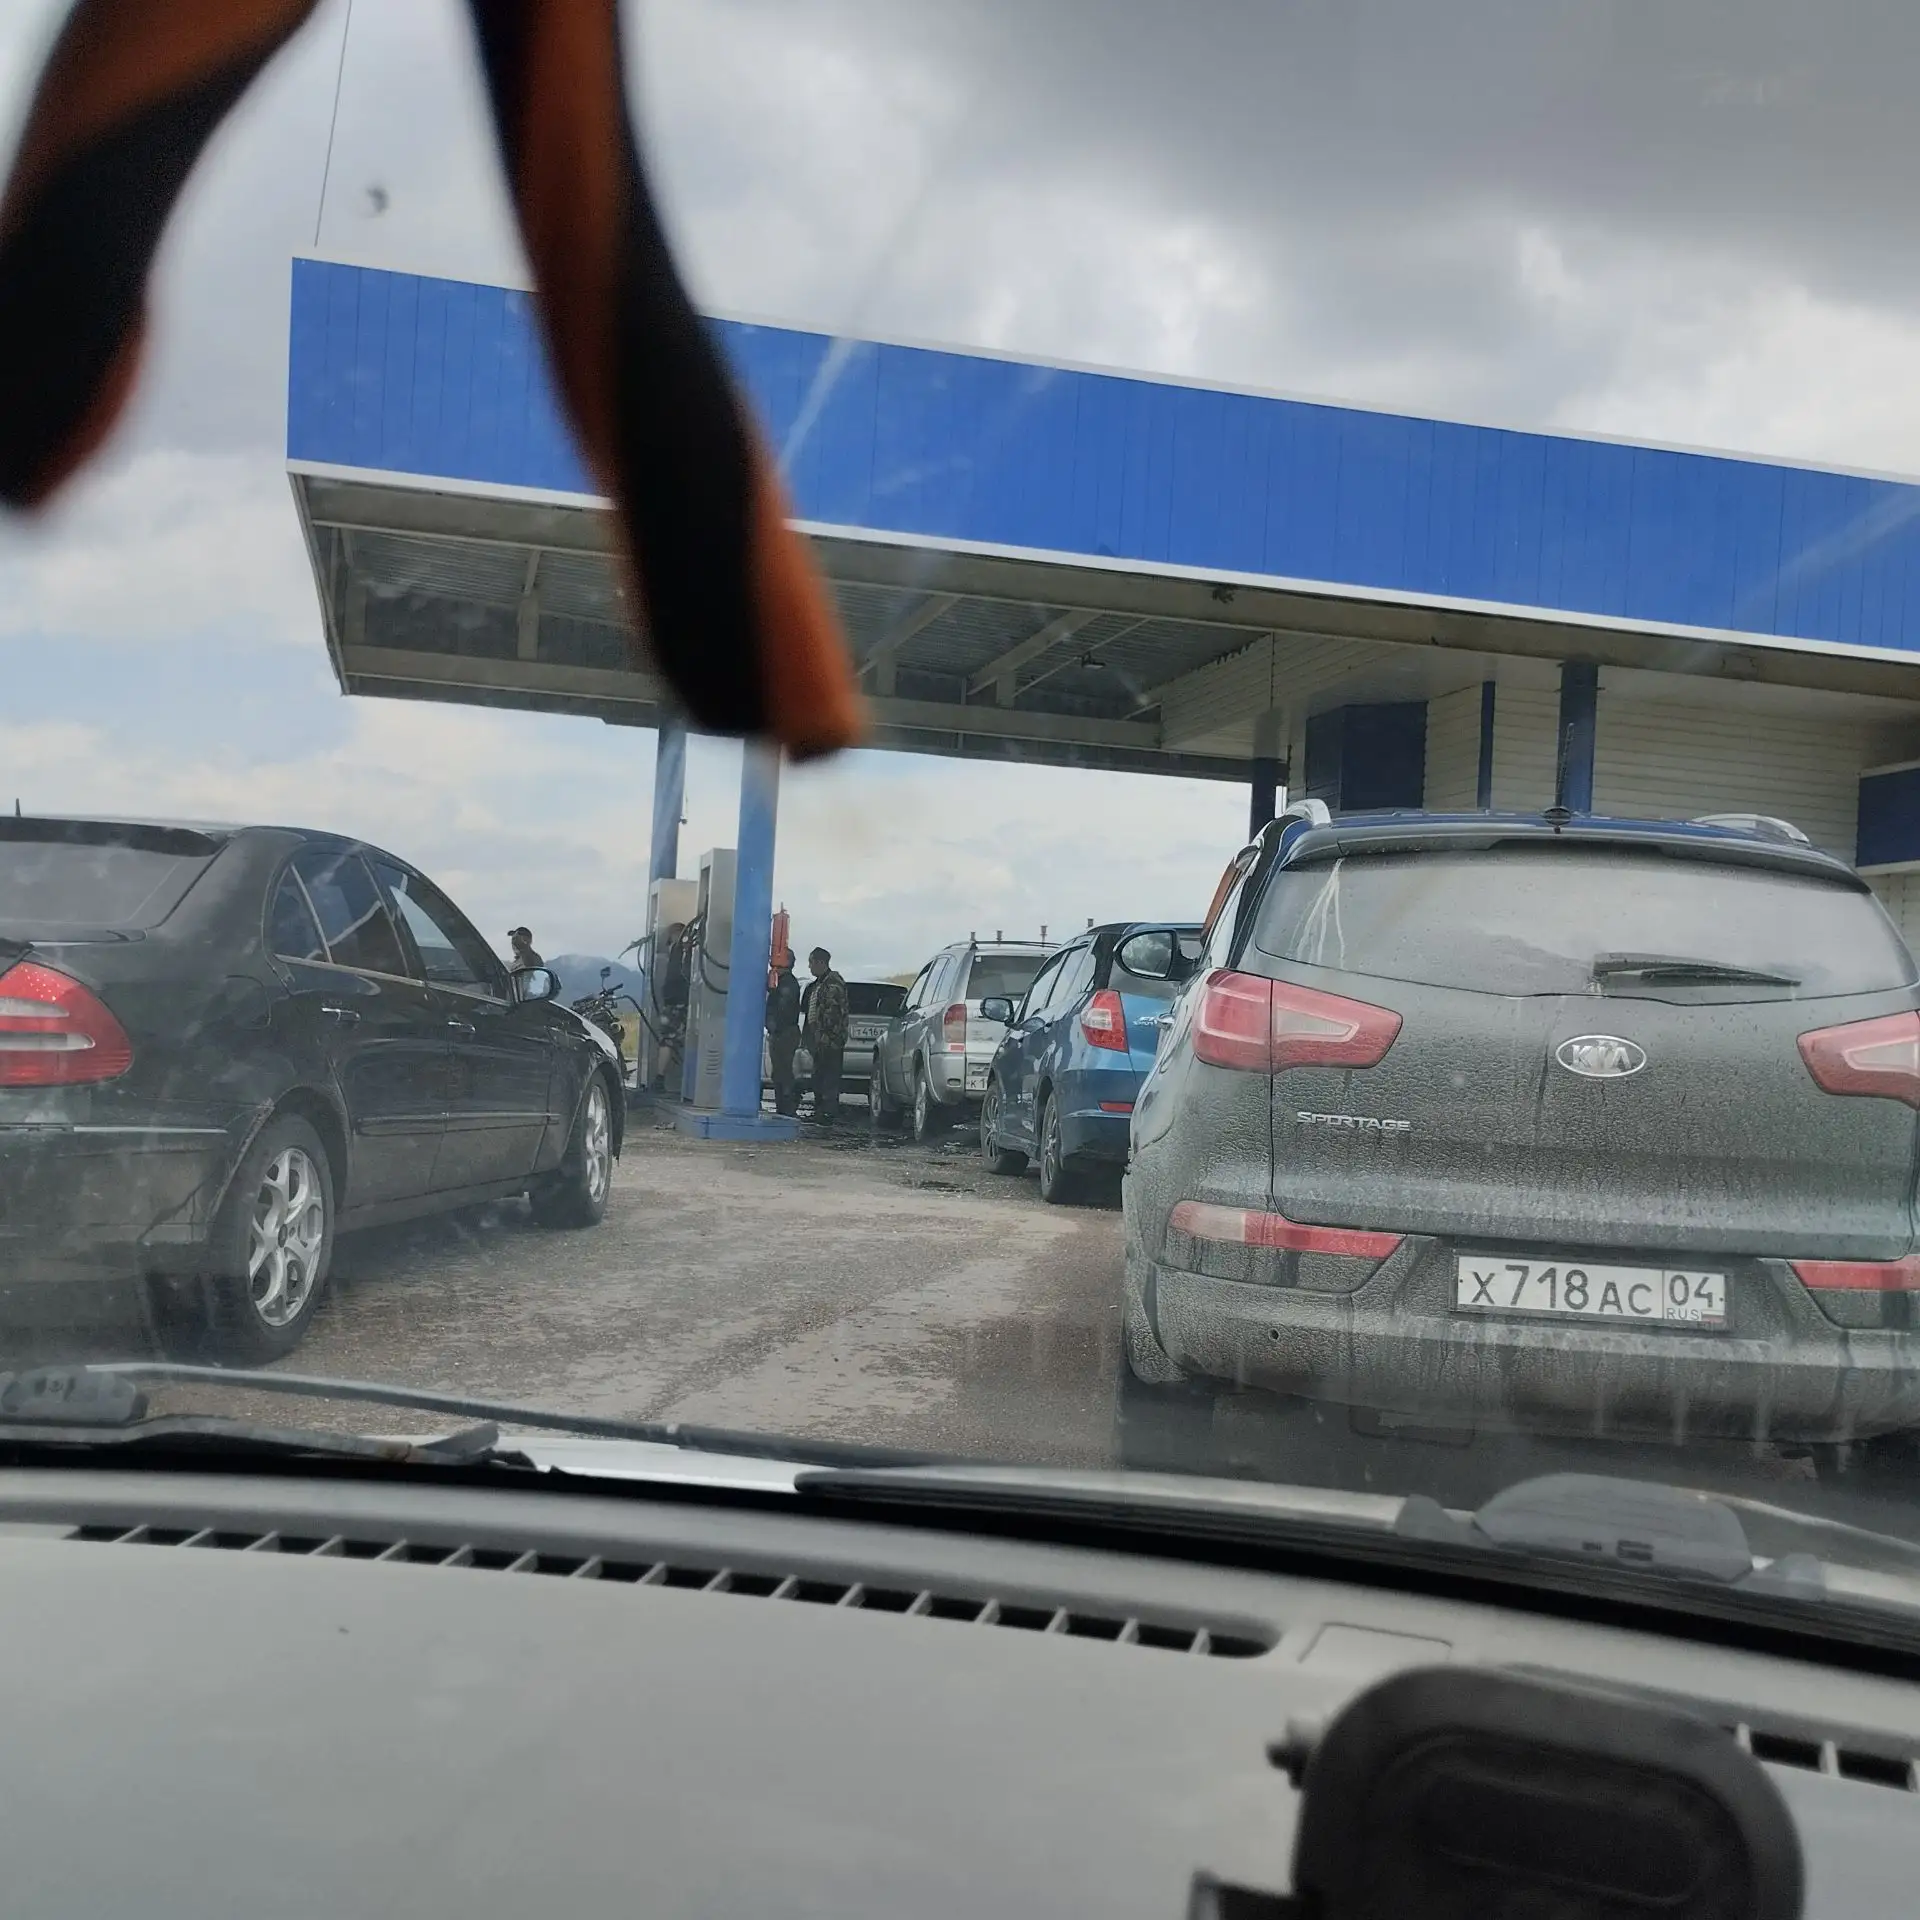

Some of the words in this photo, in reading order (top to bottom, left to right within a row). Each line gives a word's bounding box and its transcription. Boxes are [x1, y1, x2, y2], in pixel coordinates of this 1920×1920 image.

[1572, 1044, 1632, 1070] KIA
[1297, 1111, 1411, 1131] SPORTAGE
[1669, 1274, 1714, 1308] 04
[1666, 1307, 1700, 1321] RUS
